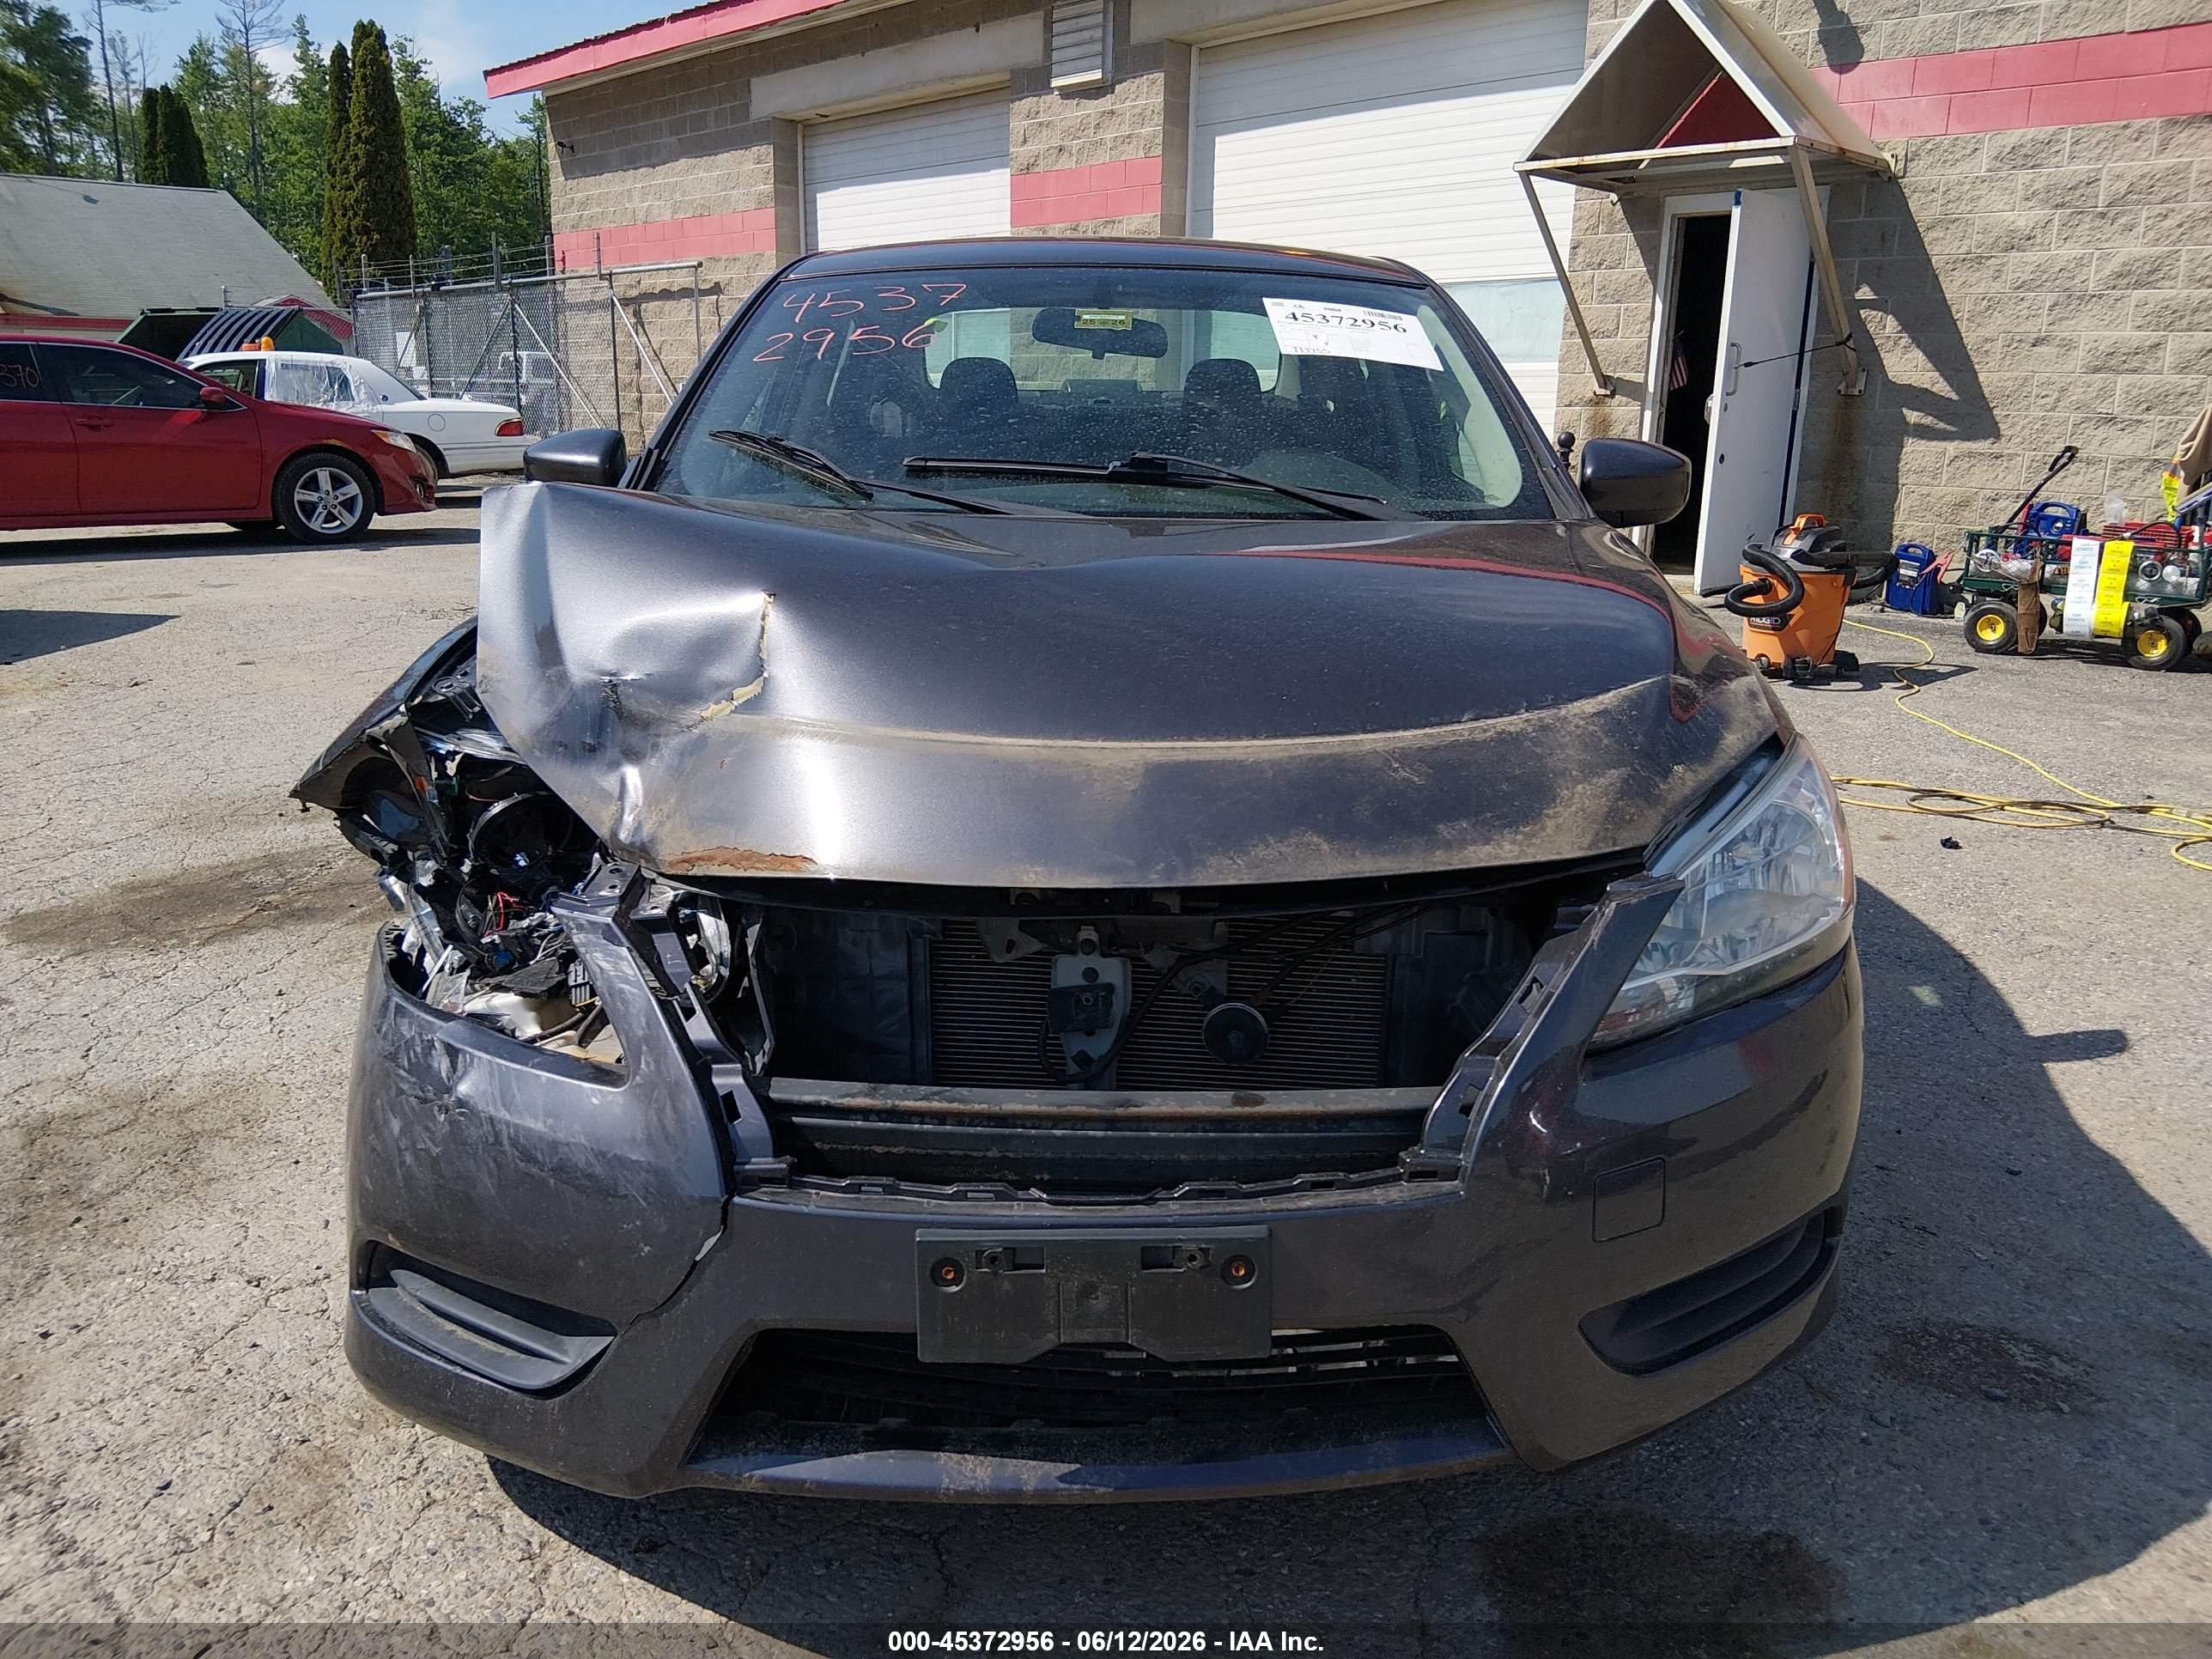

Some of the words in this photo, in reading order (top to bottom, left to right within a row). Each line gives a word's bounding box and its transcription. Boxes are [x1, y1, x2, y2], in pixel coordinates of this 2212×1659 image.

[783, 283, 968, 324] 4537
[1285, 311, 1408, 334] 45372956
[752, 318, 939, 361] 2956
